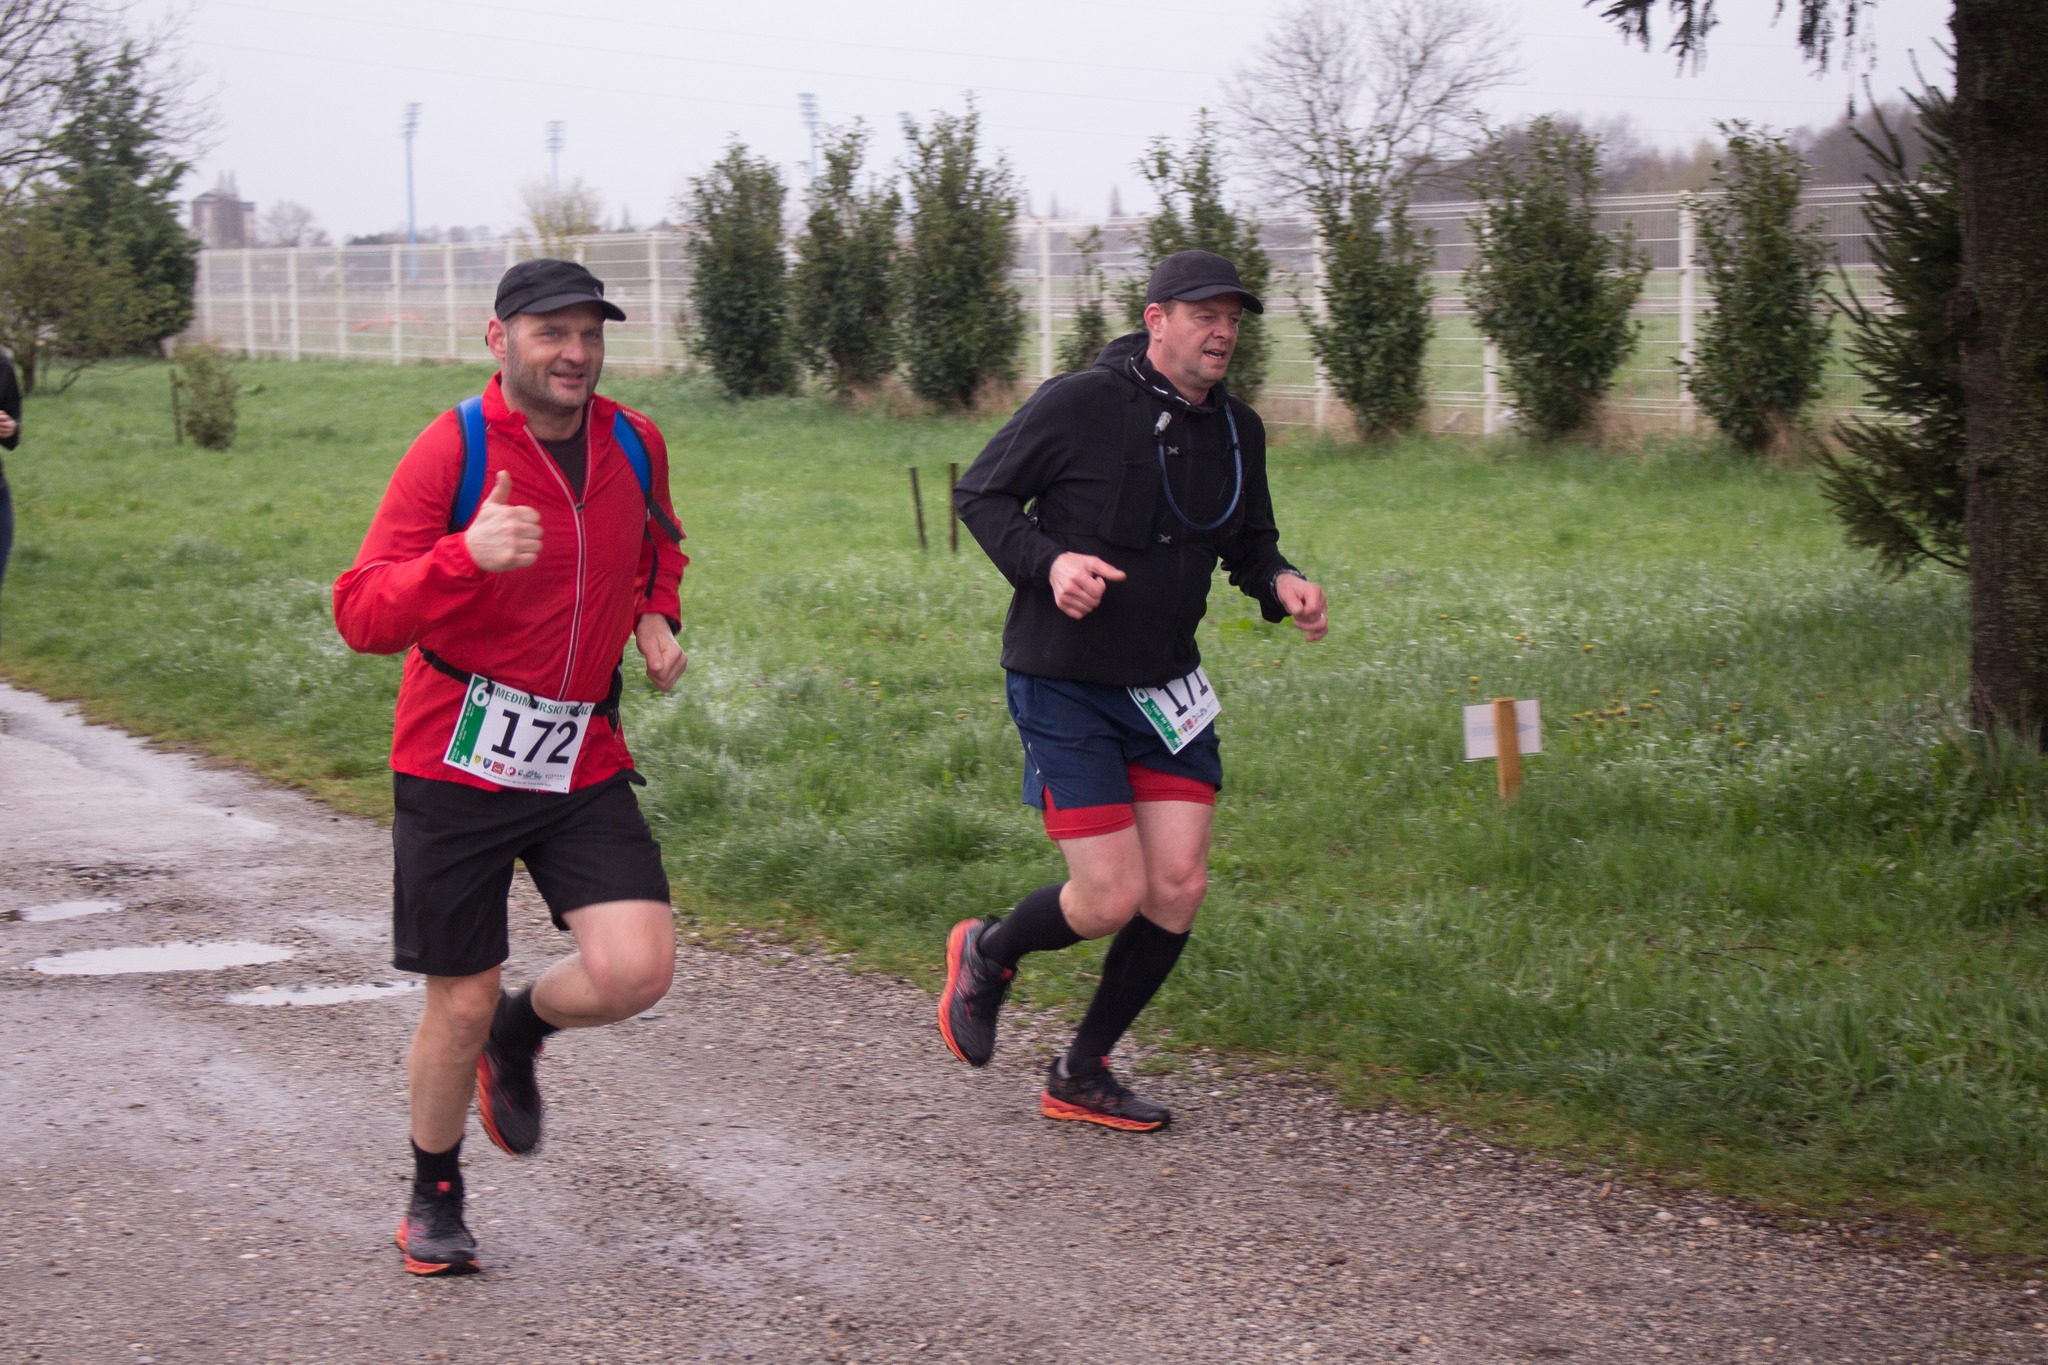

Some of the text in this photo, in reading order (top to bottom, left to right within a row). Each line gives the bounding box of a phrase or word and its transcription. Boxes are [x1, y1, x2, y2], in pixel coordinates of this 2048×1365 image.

[472, 682, 490, 707] 6
[495, 687, 563, 715] MEĐIMRSKI
[491, 709, 578, 764] 172
